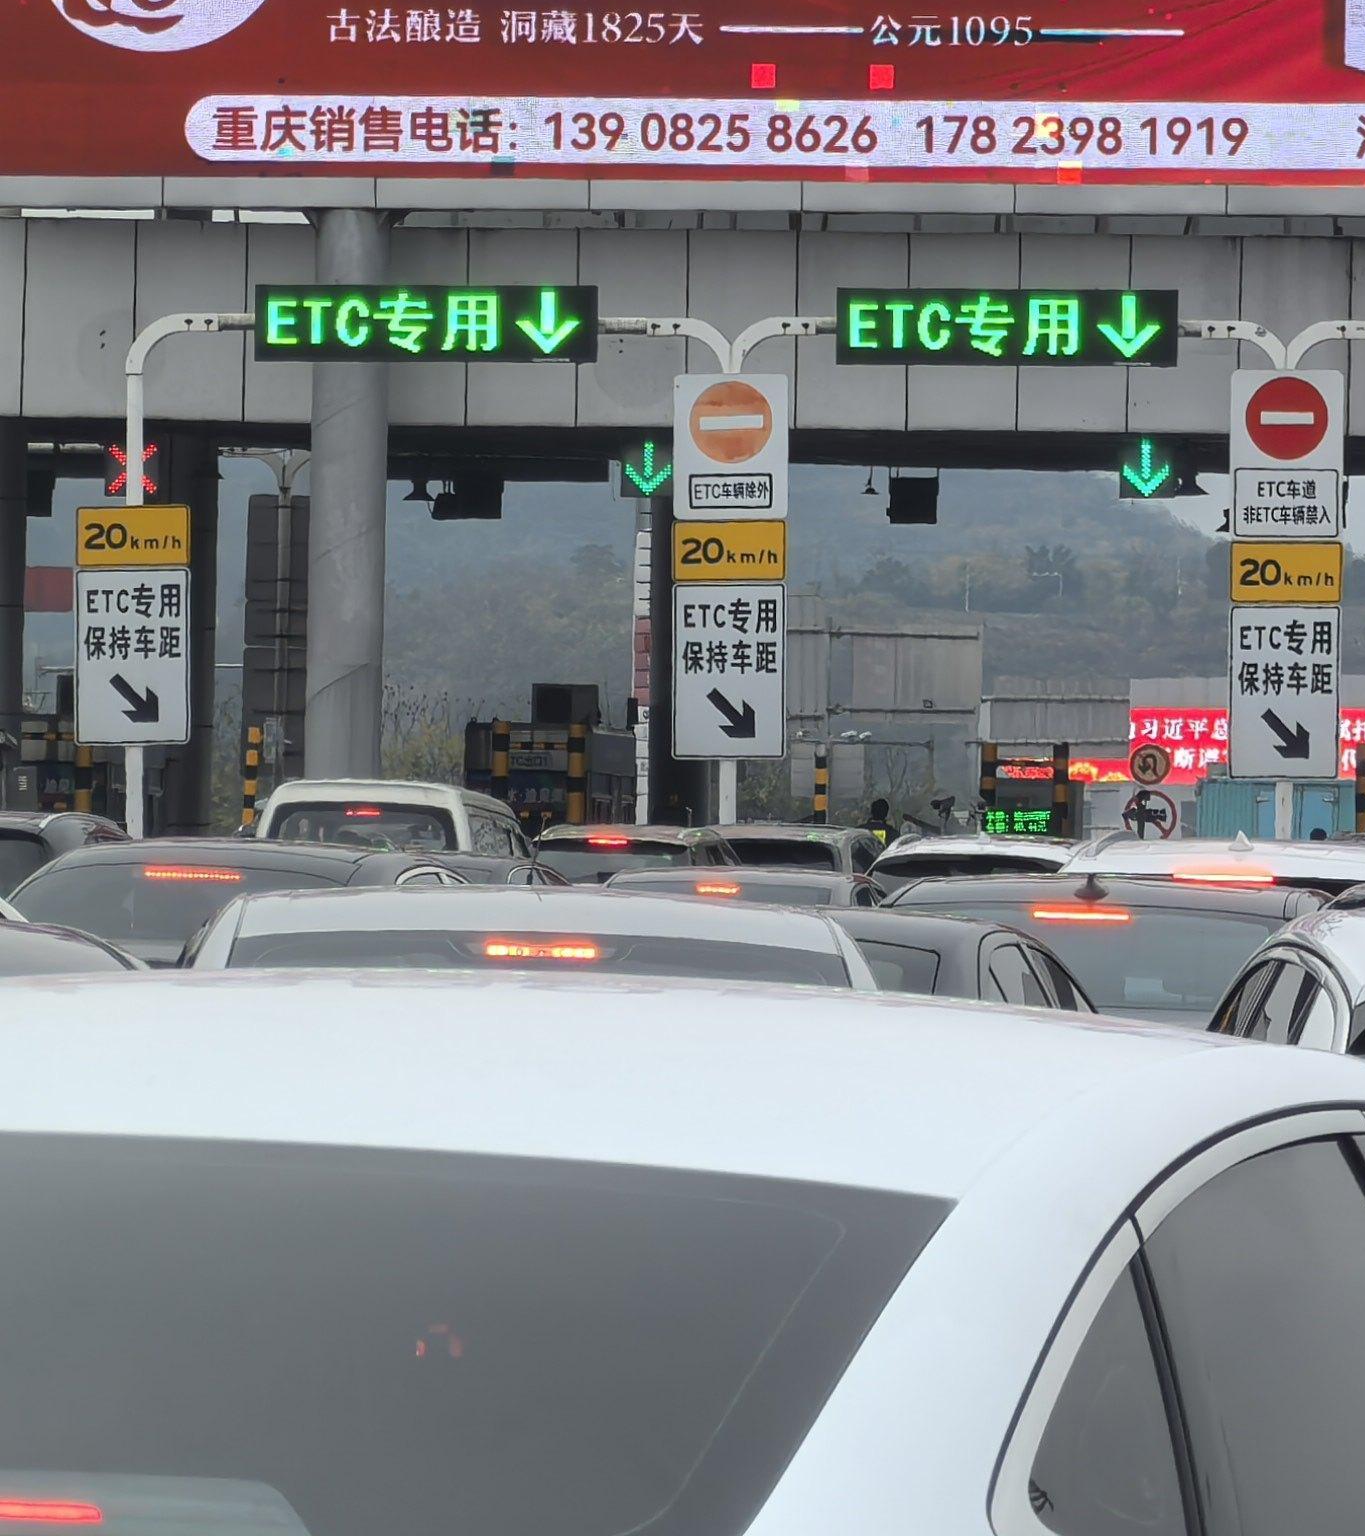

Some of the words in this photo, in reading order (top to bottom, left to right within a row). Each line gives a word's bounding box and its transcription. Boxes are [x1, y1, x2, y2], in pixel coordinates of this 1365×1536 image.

[326, 8, 482, 45] 古法酿造
[500, 9, 704, 46] 洞藏1825天
[871, 14, 1033, 47] 公元1095
[212, 105, 518, 154] 重庆销售电话：
[544, 111, 624, 152] 139
[640, 112, 750, 153] 0825
[766, 114, 878, 154] 8626
[915, 115, 998, 154] 178
[1011, 116, 1123, 156] 2398
[1139, 116, 1250, 157] 1919
[266, 292, 498, 354] ETC专用
[848, 296, 1079, 357] ETC专用
[1257, 479, 1317, 499] ETC车道
[1242, 504, 1332, 525] 非ETC车辆禁入
[86, 582, 181, 619] ETC专用
[683, 597, 777, 634] ETC专用
[84, 624, 182, 661] 保持车距
[1239, 619, 1333, 656] ETC专用
[682, 639, 778, 675] 保持车距
[1238, 660, 1334, 697] 保持车距
